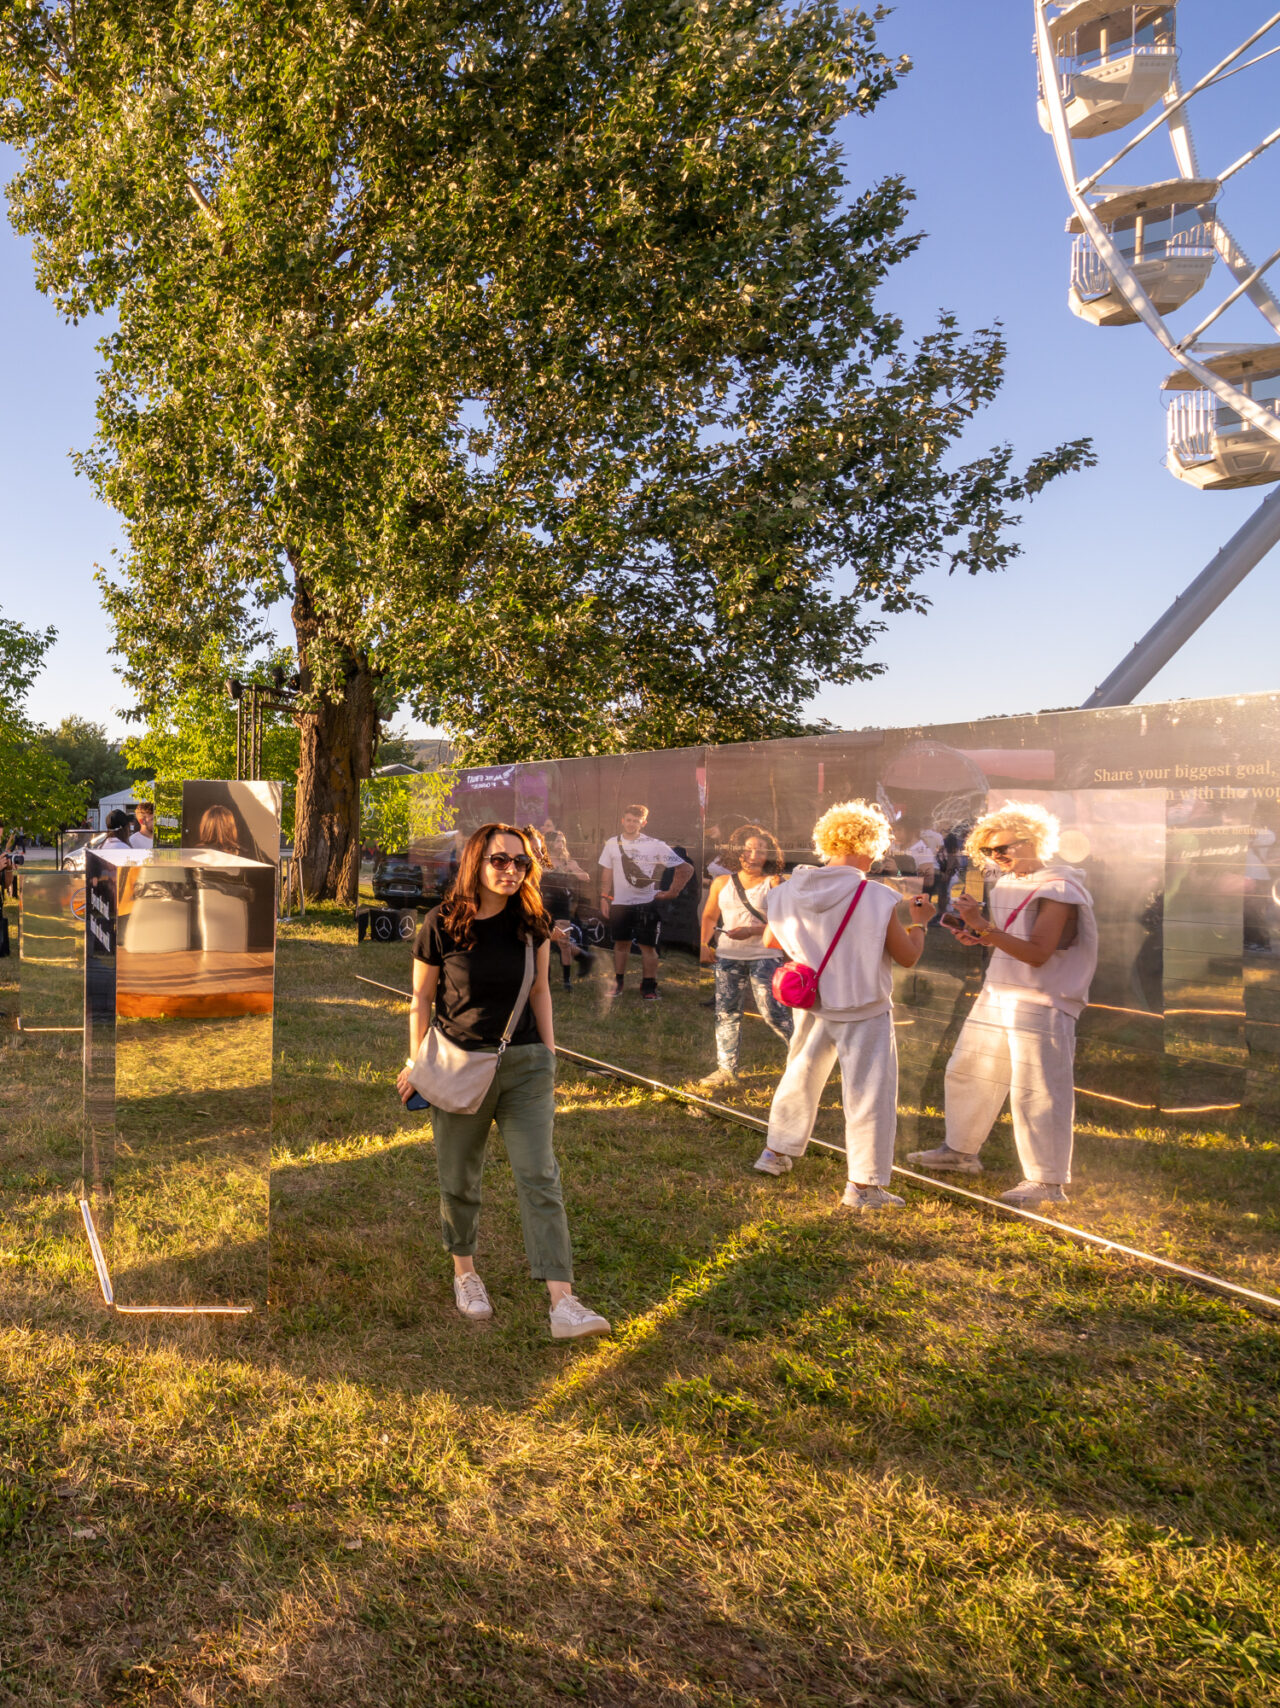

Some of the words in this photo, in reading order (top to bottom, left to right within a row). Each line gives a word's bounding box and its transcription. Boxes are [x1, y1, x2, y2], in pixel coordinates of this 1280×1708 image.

[1094, 768, 1134, 783] Share
[1137, 767, 1171, 784] your
[1175, 764, 1231, 782] biggest
[1236, 760, 1277, 780] goal,
[1179, 785, 1215, 801] with
[1219, 784, 1247, 799] the
